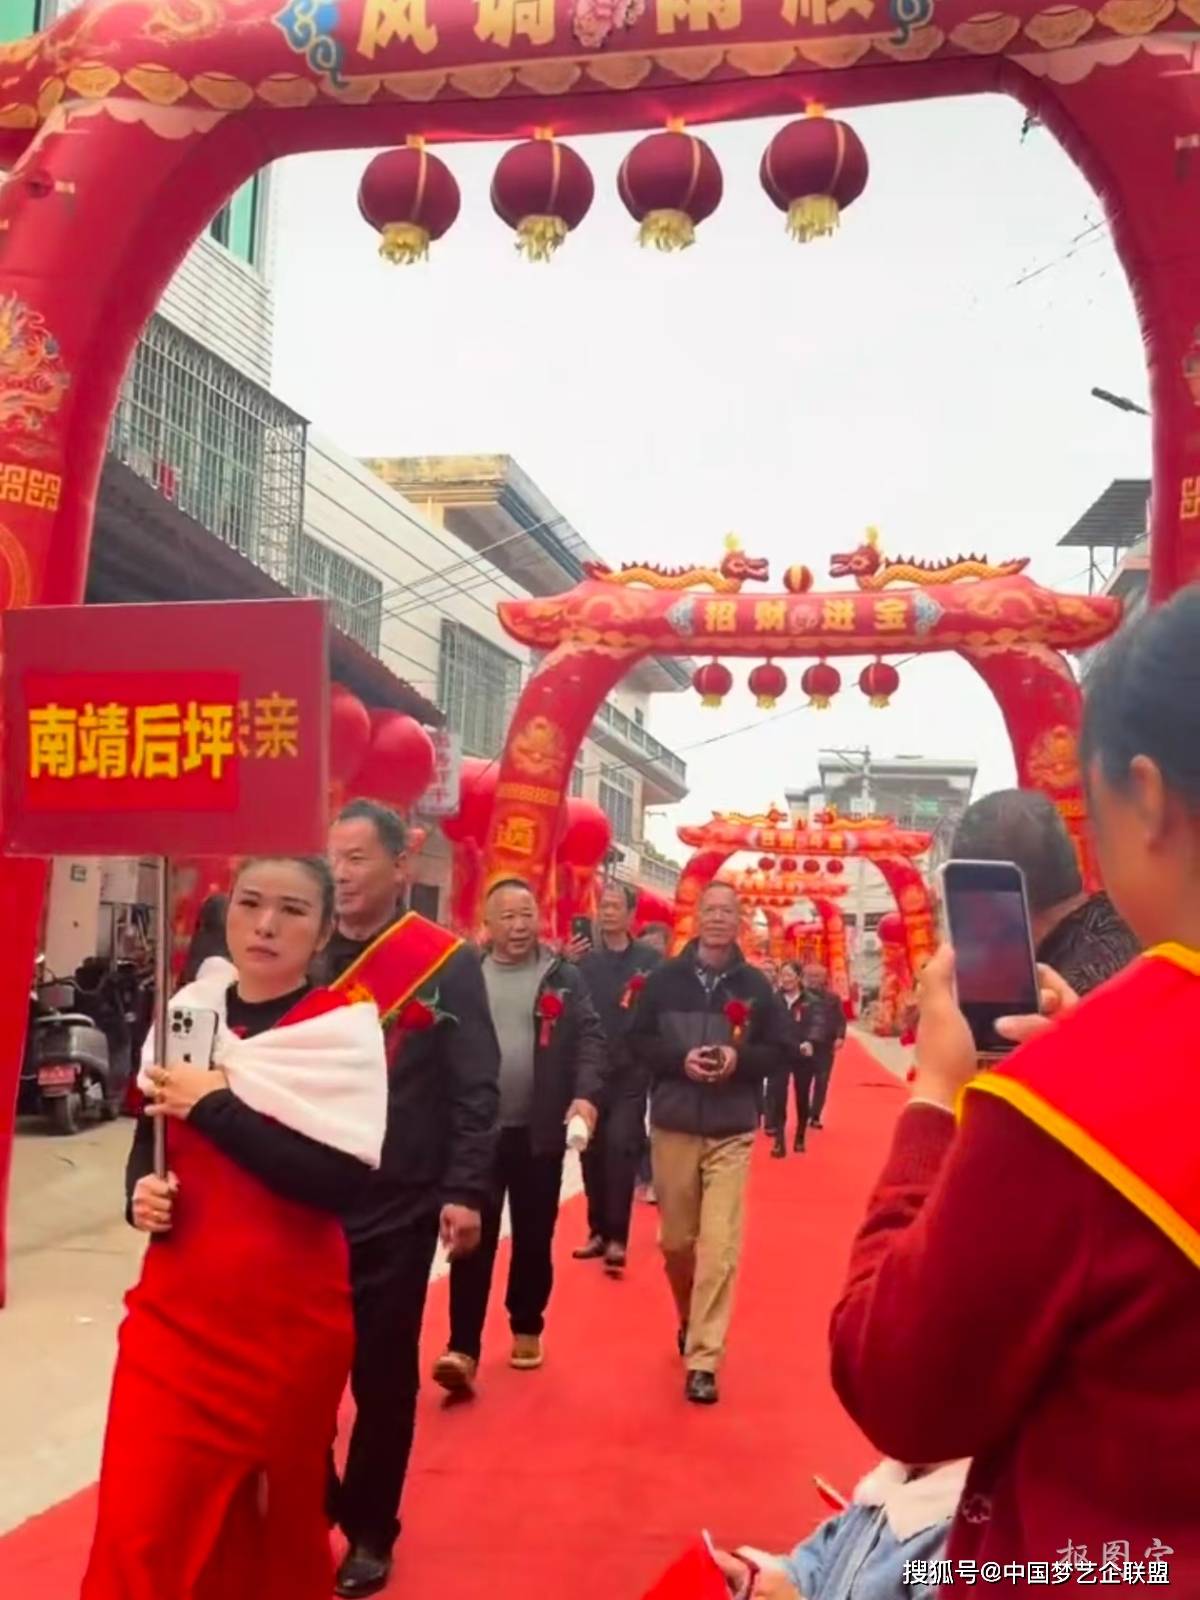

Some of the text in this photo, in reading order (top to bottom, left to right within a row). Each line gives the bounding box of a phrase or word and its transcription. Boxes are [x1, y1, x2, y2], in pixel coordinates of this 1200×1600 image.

[705, 598, 908, 631] 招财进宝
[29, 702, 234, 780] 南靖后坪
